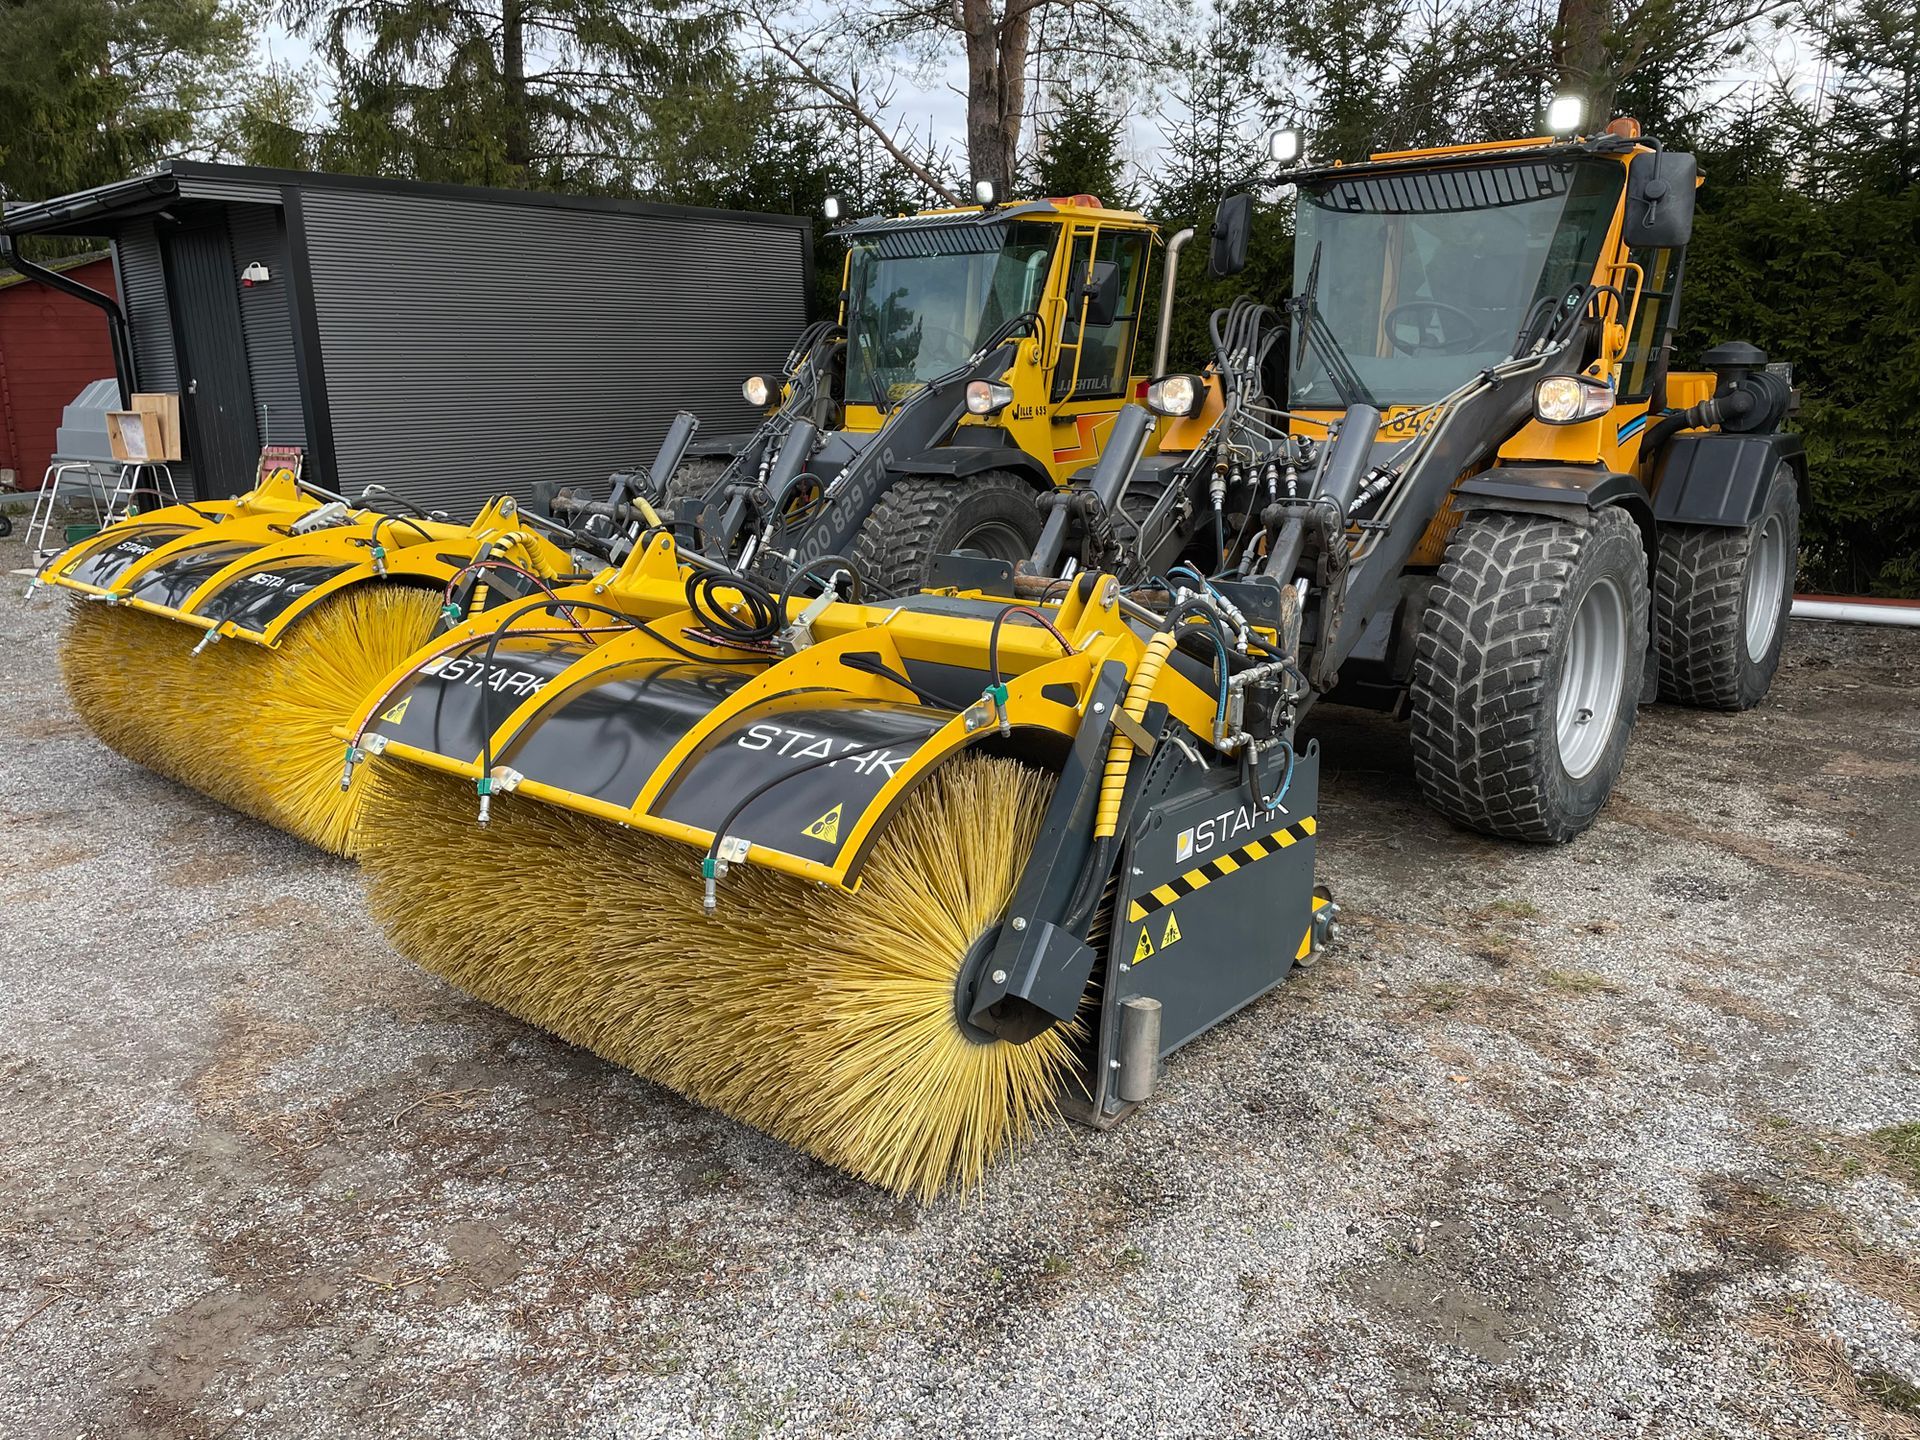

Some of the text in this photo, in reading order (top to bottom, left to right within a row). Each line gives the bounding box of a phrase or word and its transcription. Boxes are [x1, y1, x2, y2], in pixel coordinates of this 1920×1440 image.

[832, 484, 864, 534] 829
[864, 447, 895, 496] 549
[256, 574, 305, 593] STAK
